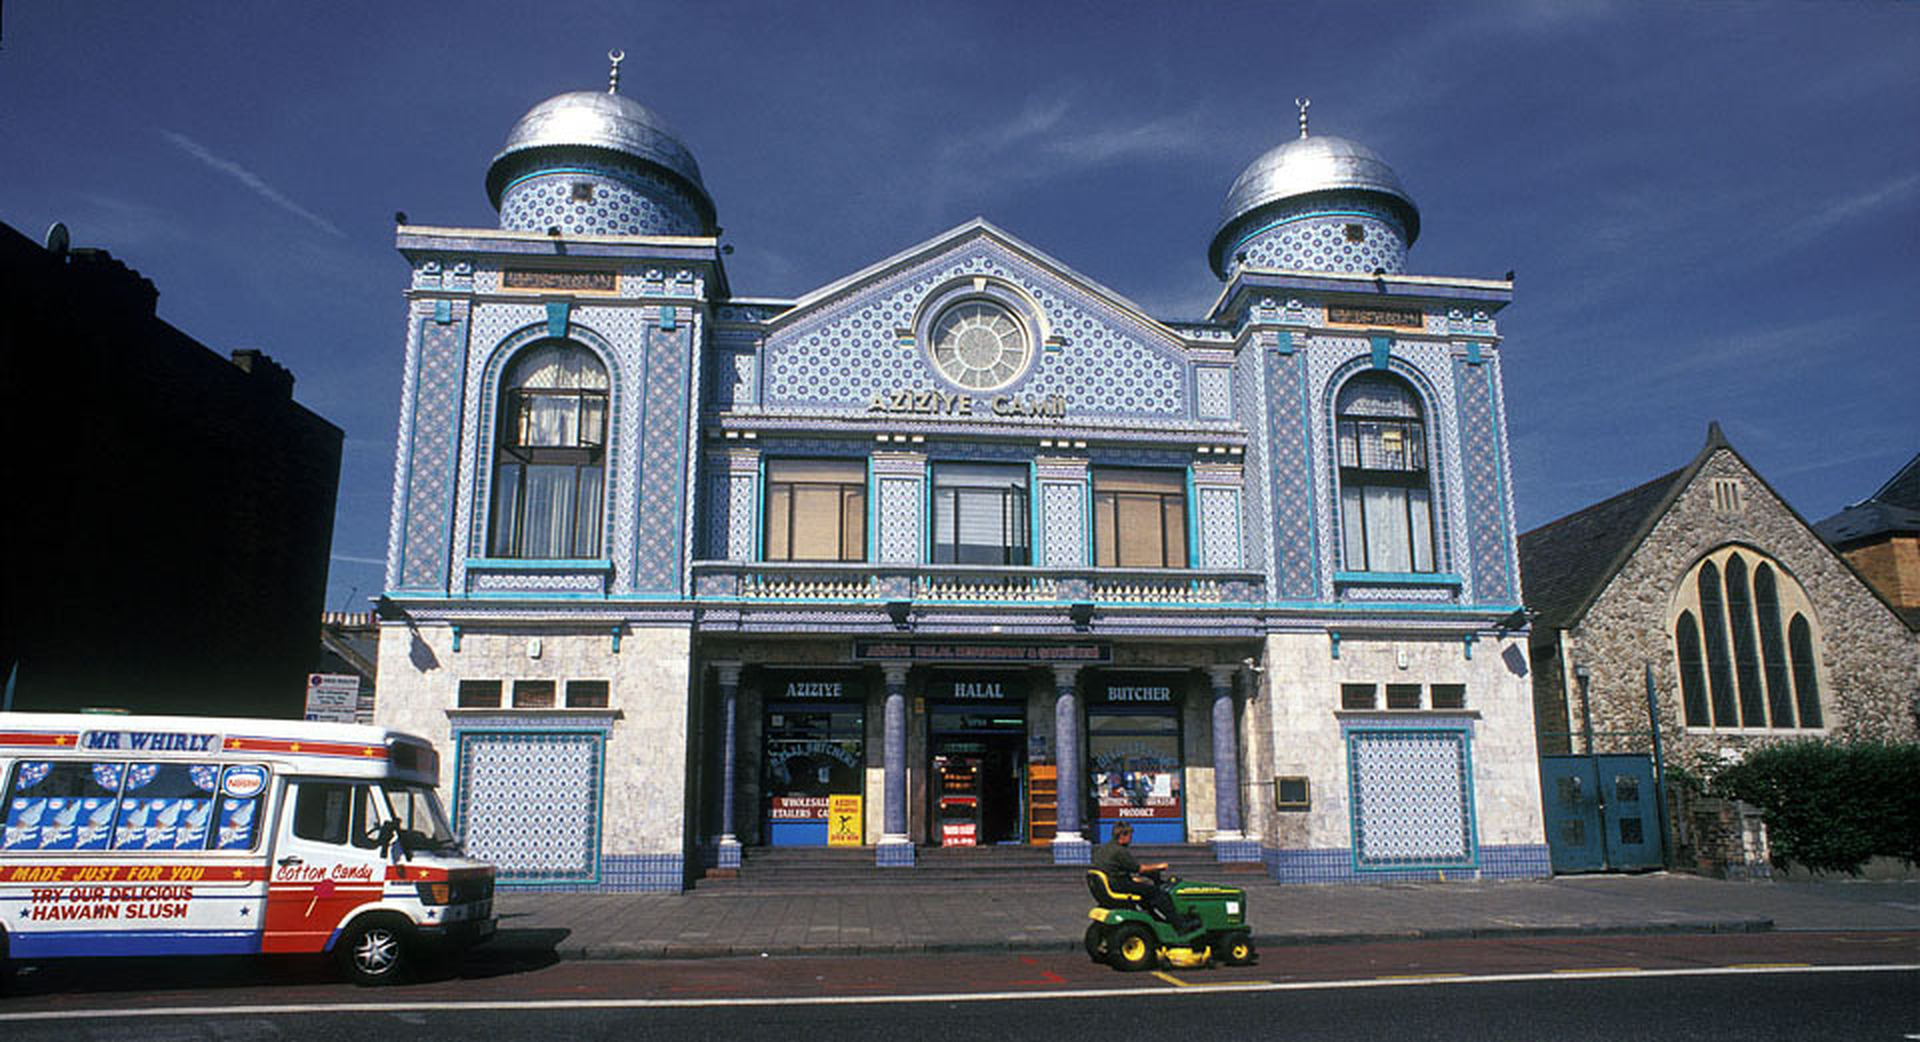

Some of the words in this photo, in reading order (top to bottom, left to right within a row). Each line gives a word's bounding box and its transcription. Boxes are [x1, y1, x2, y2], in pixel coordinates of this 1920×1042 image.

[954, 683, 1004, 698] HALAL
[1108, 687, 1171, 701] BUTCHER
[88, 731, 121, 749] MR
[130, 732, 216, 751] WHIRLY
[10, 867, 67, 881] MADE
[73, 867, 124, 881] JUST
[127, 867, 164, 881] FOR
[170, 867, 206, 881] YOU
[276, 863, 328, 881] Cotton
[331, 863, 373, 882] Candy
[31, 888, 64, 904] TRY
[68, 886, 105, 902] OUR
[109, 885, 193, 902] DELICIOUS
[125, 903, 188, 919] SLUSH
